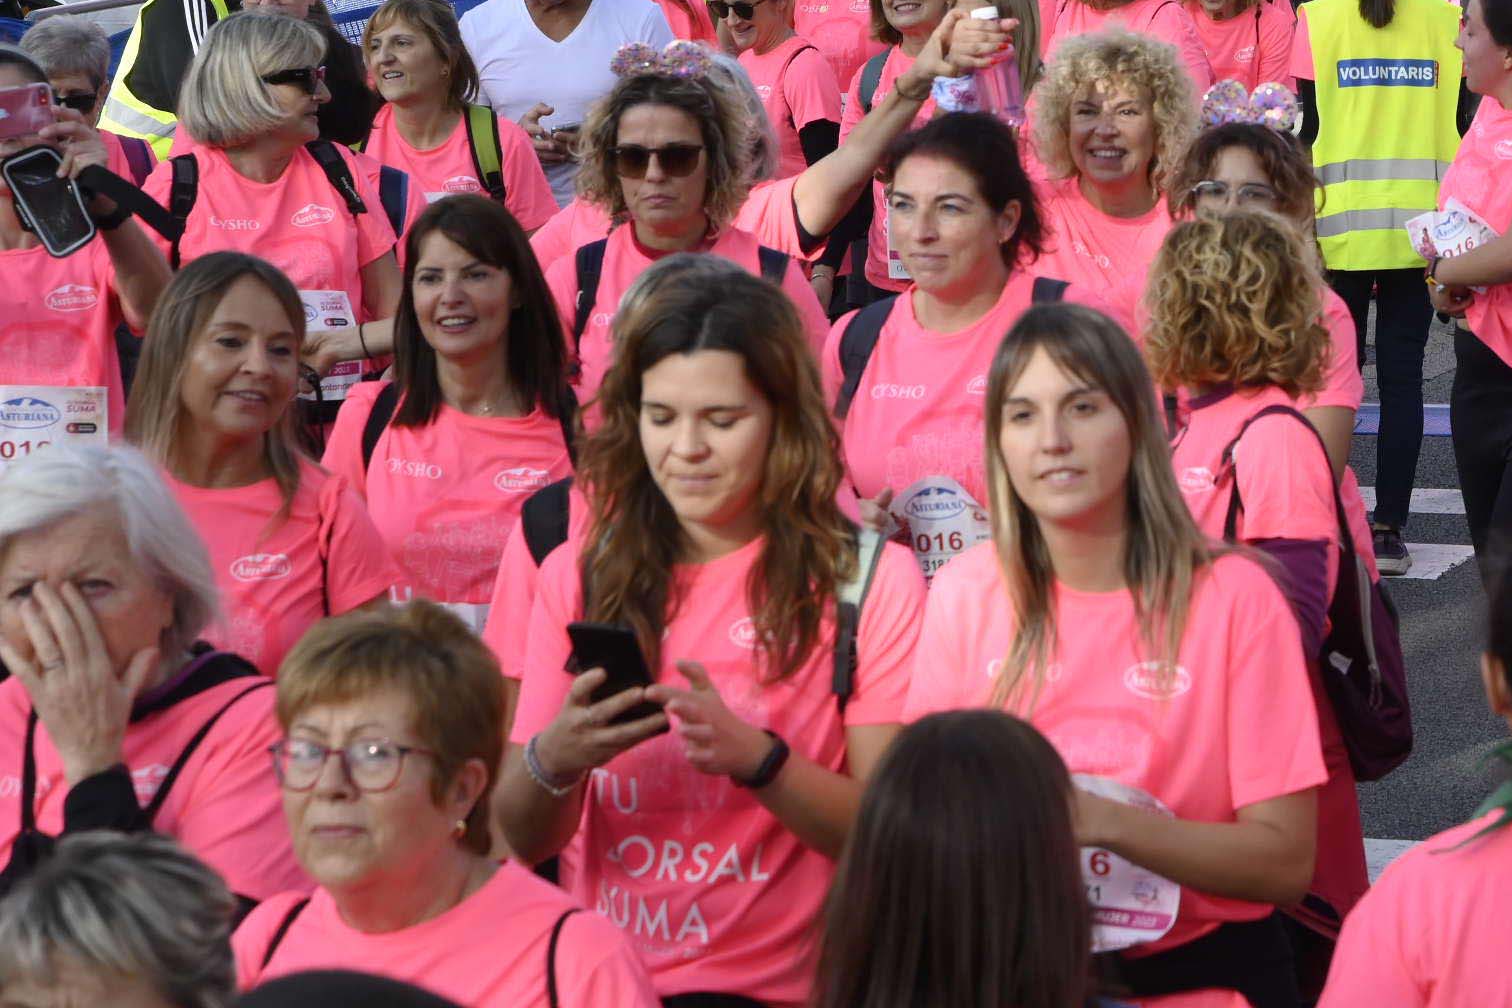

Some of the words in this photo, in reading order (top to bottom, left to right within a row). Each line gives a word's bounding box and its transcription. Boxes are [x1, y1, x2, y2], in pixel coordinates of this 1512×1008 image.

[1340, 64, 1433, 81] VOLUNTARIS
[871, 384, 925, 399] OYSHO
[66, 404, 96, 413] SUMA
[916, 532, 964, 553] 016
[593, 768, 638, 815] TU
